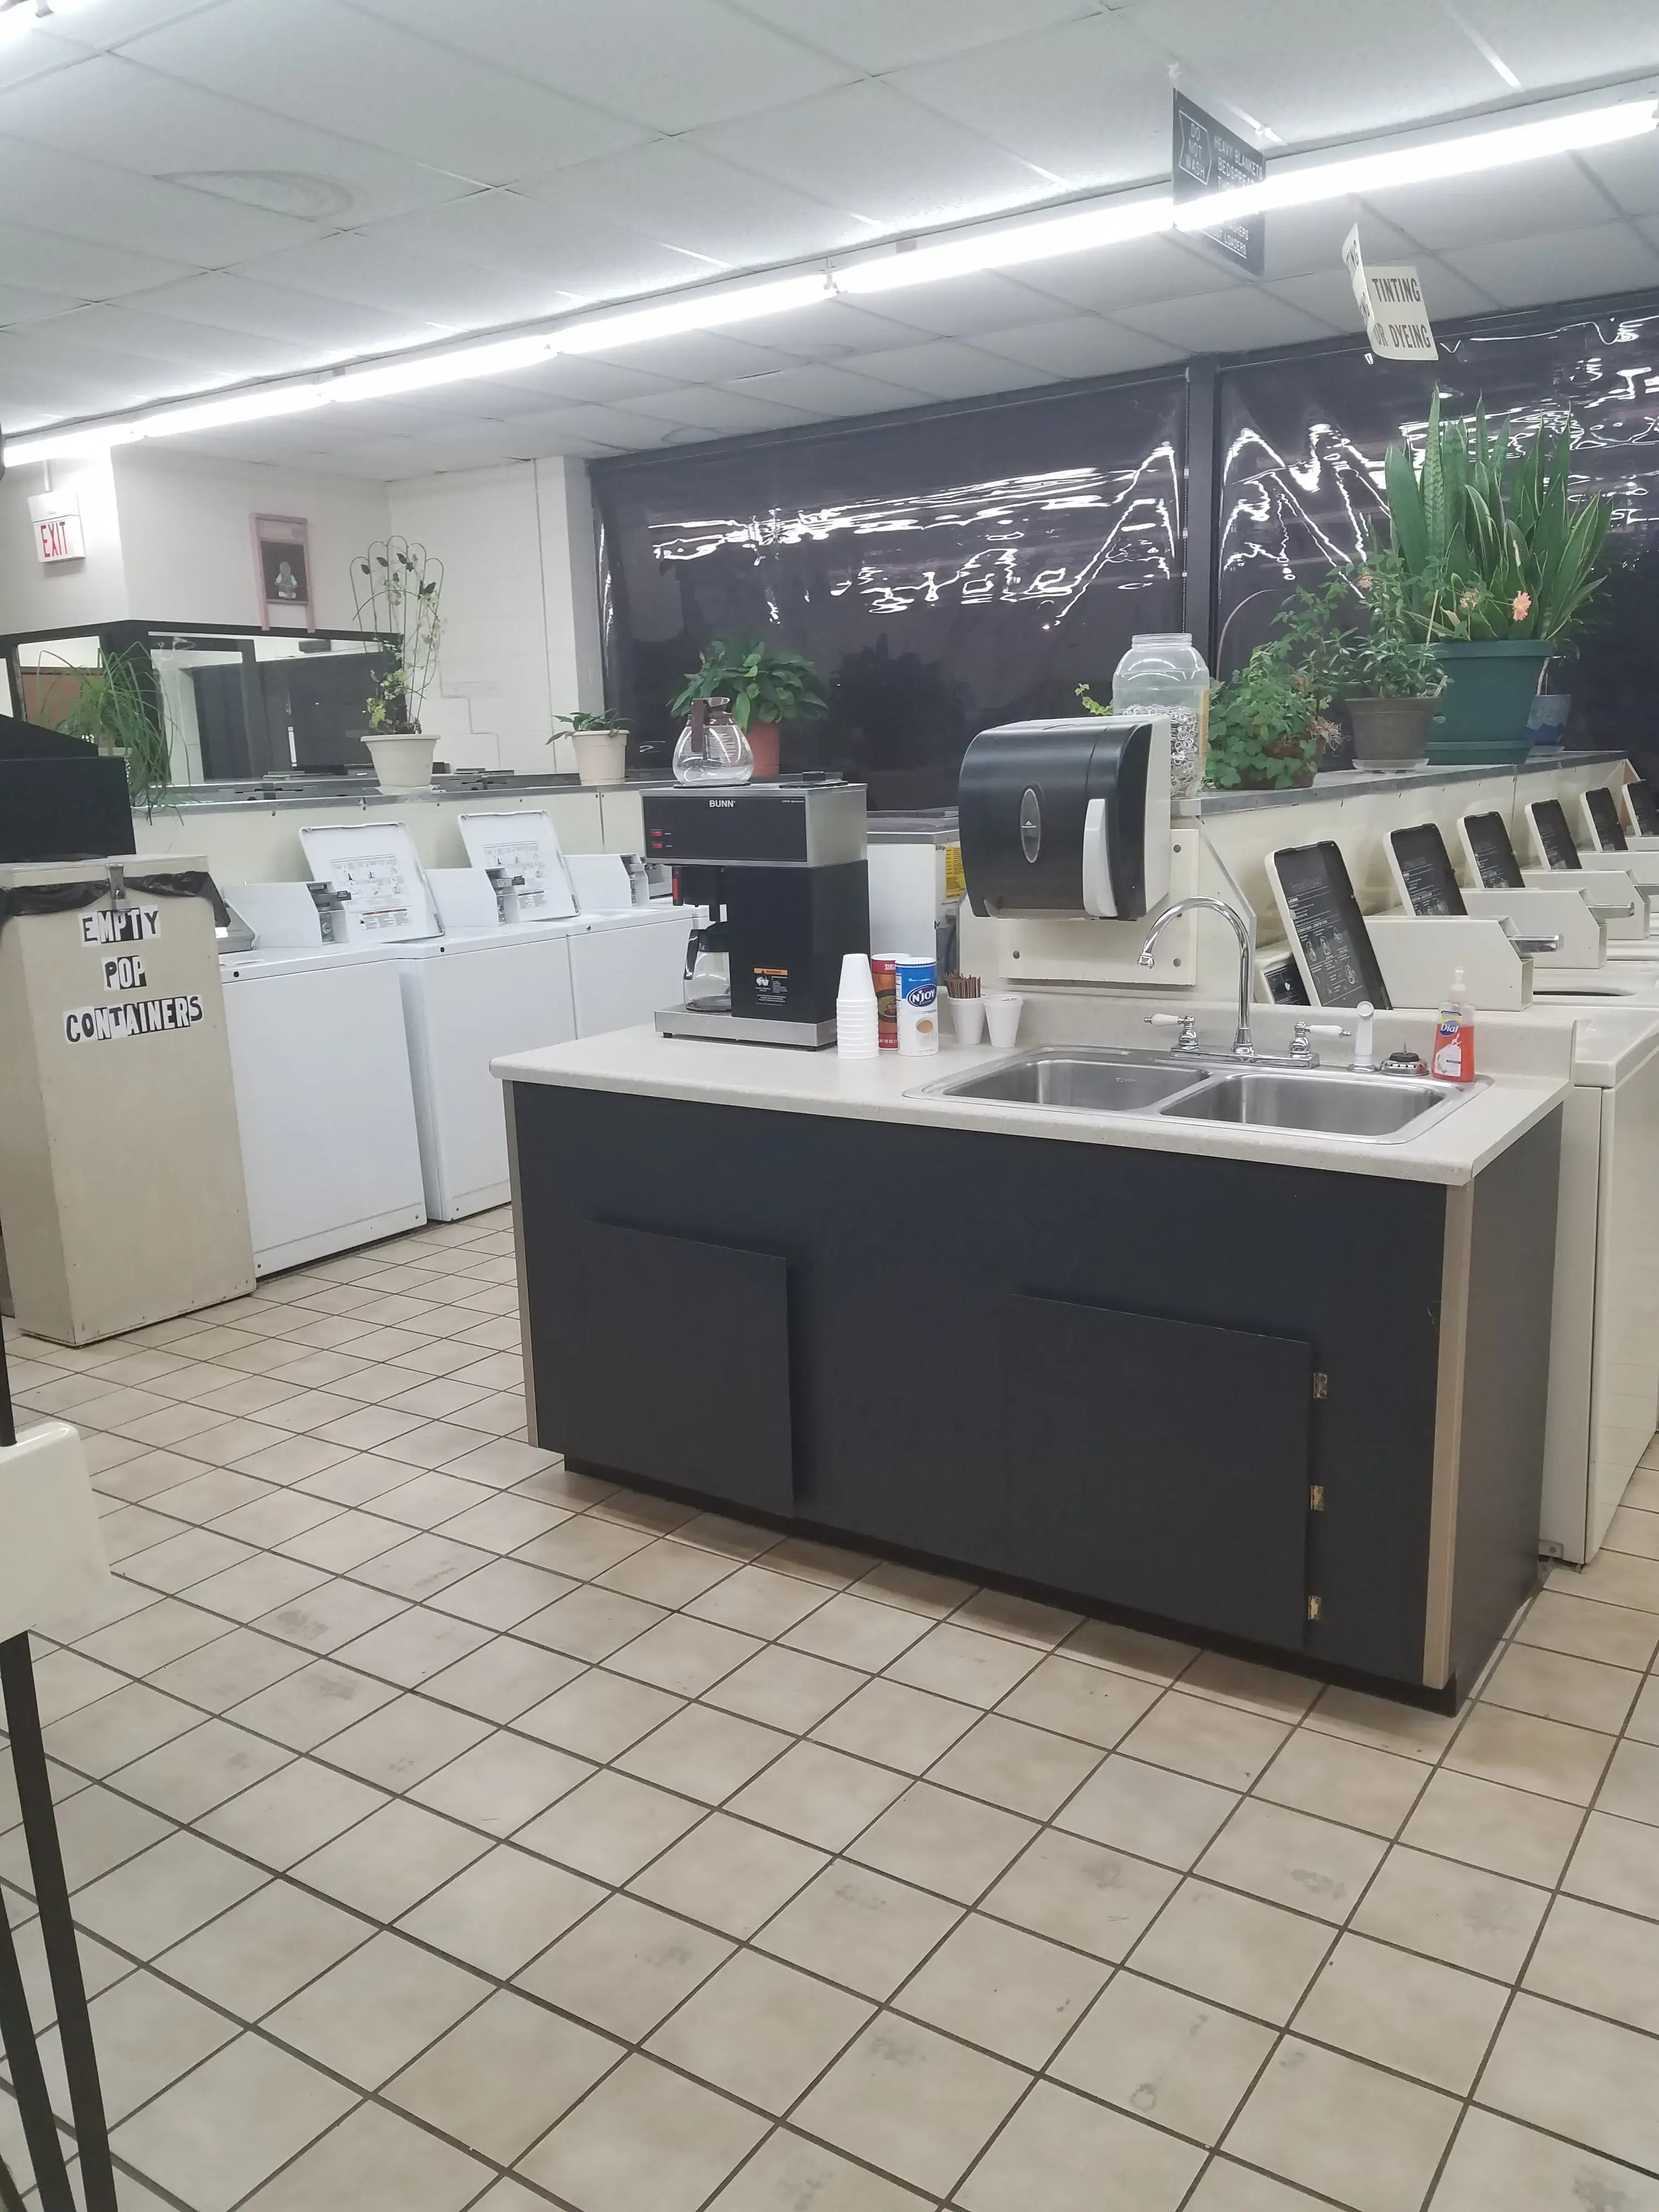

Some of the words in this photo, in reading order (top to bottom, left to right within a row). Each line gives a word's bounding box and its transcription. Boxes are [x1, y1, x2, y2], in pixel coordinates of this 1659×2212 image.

[1190, 122, 1200, 141] DO
[1188, 138, 1202, 160] NOT
[1185, 154, 1205, 179] WASH
[1372, 278, 1421, 302] TINTING
[1373, 323, 1389, 347] OR
[1389, 324, 1431, 348] DYEING
[41, 521, 67, 557] EXIT
[82, 908, 159, 943] EMPTY
[105, 955, 146, 989] POP
[66, 996, 203, 1042] CONTAINERS
[1441, 1023, 1459, 1033] Dial
